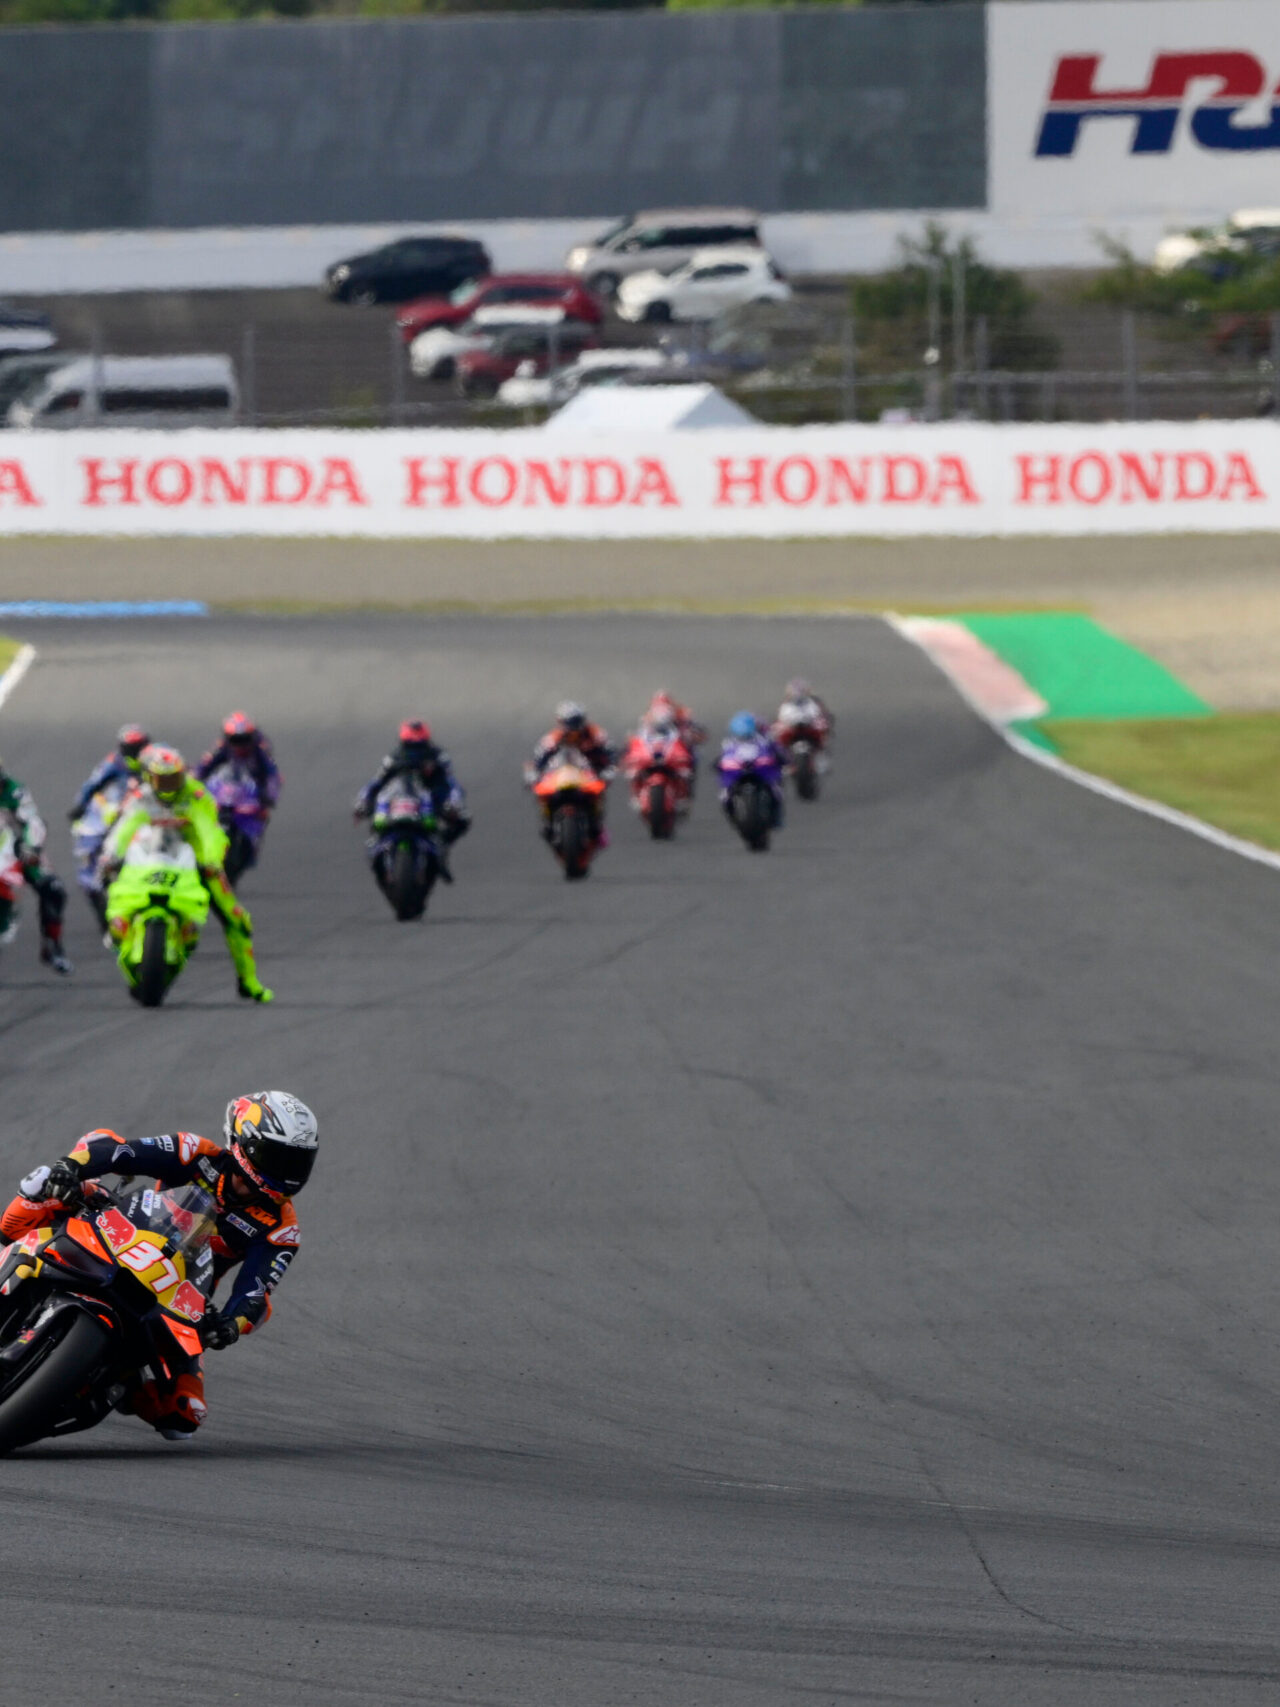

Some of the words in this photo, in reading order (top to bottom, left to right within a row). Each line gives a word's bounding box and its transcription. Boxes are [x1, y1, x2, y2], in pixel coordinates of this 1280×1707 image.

[1032, 50, 1280, 158] HR
[81, 456, 369, 507] HONDA
[404, 456, 681, 508] HONDA
[714, 454, 982, 507] HONDA
[1012, 449, 1267, 506] HONDA
[244, 1206, 278, 1227] KTM
[117, 1240, 181, 1294] 37
